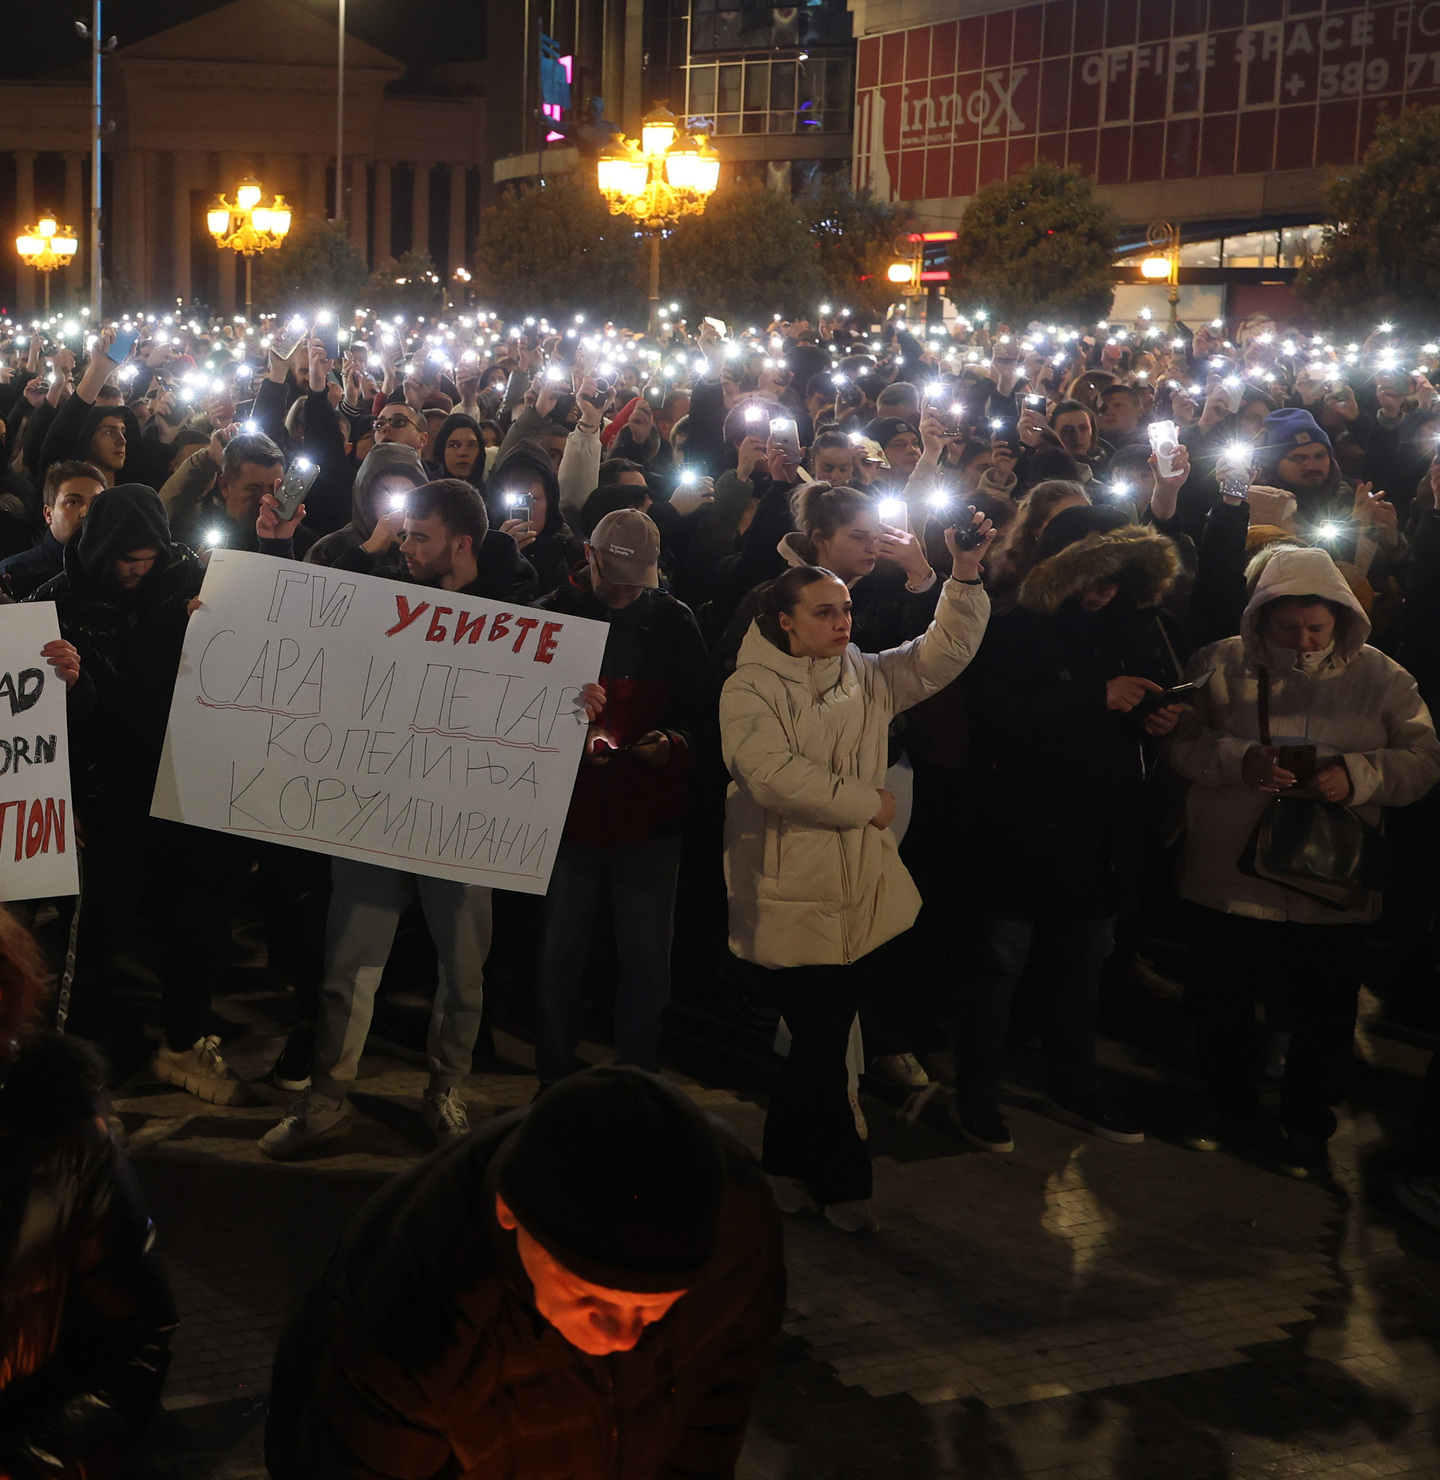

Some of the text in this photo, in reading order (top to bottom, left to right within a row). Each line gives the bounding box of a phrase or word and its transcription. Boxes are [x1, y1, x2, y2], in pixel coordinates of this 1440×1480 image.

[1081, 36, 1216, 86] OFFICE
[1234, 11, 1375, 64] SPACE
[1319, 58, 1389, 98] 389
[266, 568, 565, 665] ГИ УБИВТЕ
[199, 629, 586, 746] САРА И ПЕТАР
[228, 760, 550, 872] КОРУМПИРАНИ
